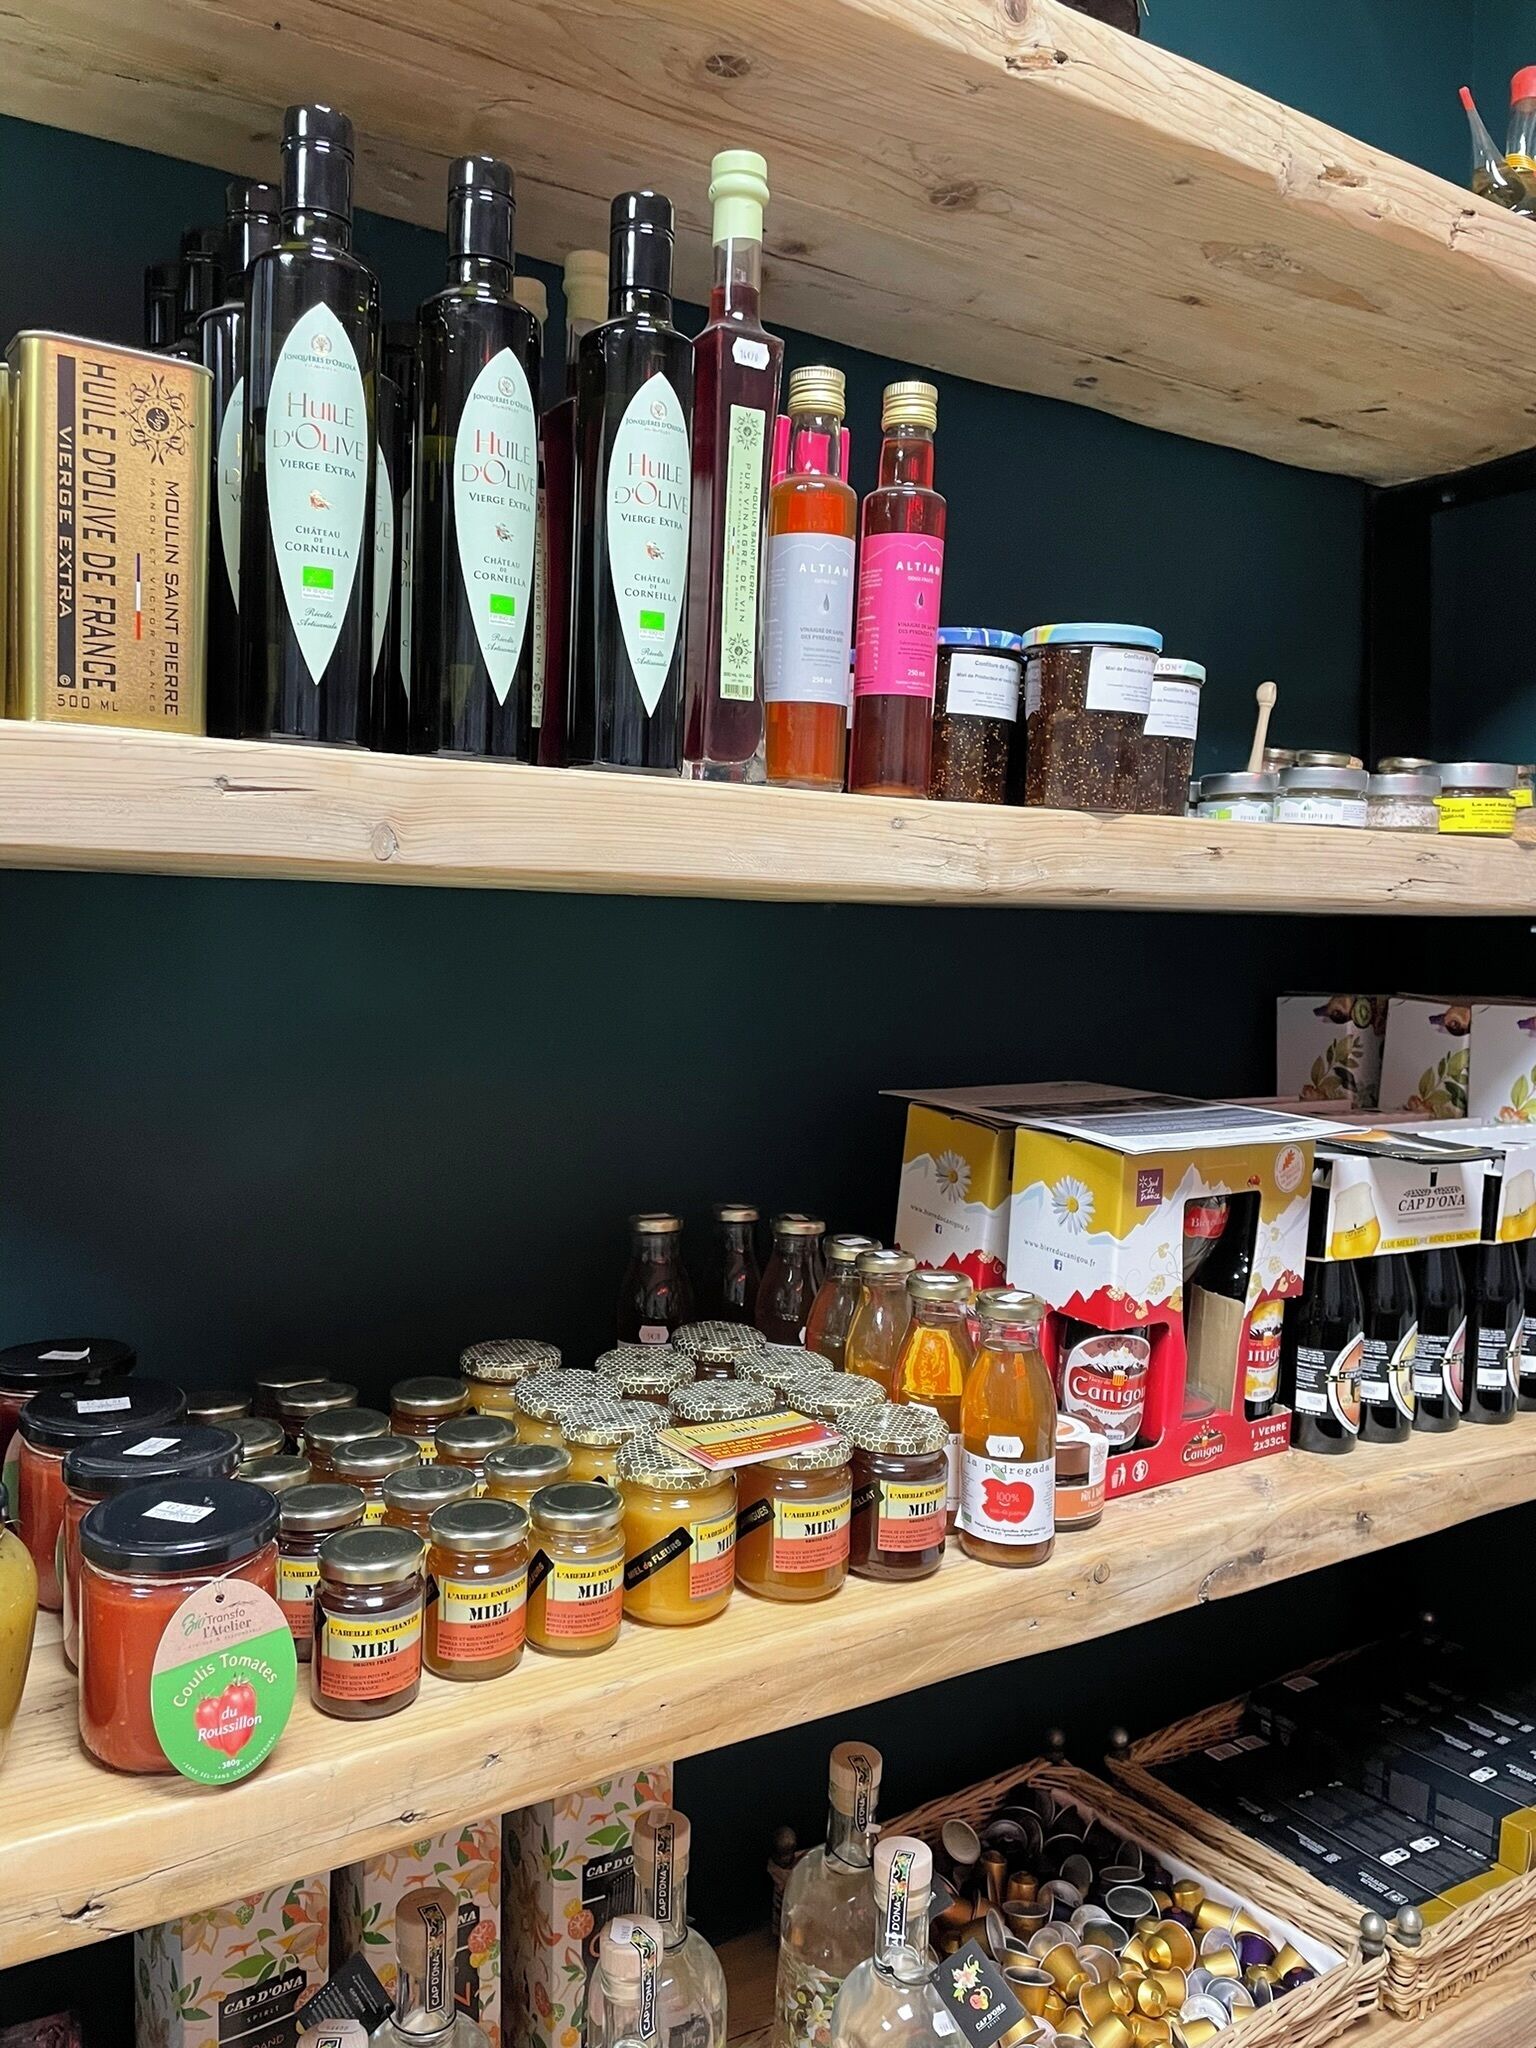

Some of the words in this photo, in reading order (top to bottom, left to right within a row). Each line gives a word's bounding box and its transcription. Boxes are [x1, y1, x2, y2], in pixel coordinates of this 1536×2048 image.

[82, 361, 116, 440] HUILE
[288, 392, 354, 428] HUILE
[273, 422, 365, 462] D'OLIVE
[476, 430, 530, 465] HUILE
[58, 426, 73, 525] VIERGE
[280, 458, 320, 471] VIERGE
[325, 464, 356, 479] EXTRA
[462, 459, 535, 497] D'OLIVE
[628, 453, 683, 485] HUILE
[82, 448, 116, 544] D'OLIVE
[469, 492, 505, 505] VIERGE
[509, 498, 530, 512] EXTRA
[615, 481, 688, 515] D'OLIVE
[751, 487, 759, 522] MOULIN
[165, 480, 179, 564] MOULIN
[295, 525, 340, 539] CHÂTEAU
[621, 513, 656, 525] VIERGE
[659, 517, 683, 530] EXTRA
[741, 498, 750, 566] VINAIGRE
[150, 548, 156, 566] ET
[285, 541, 349, 559] CORNEILLA
[82, 552, 116, 587] DE
[484, 555, 520, 569] CHÂTEAU
[58, 535, 73, 618] EXTRA
[474, 570, 526, 588] CORNEILLA
[634, 573, 671, 585] CHÂTEAU
[740, 575, 747, 592] DE
[165, 573, 179, 635] SAINT
[625, 587, 677, 602] CORNEILLA
[82, 594, 116, 692] FRANCE
[165, 641, 179, 715] PIERRE
[907, 669, 919, 677] 250
[57, 693, 90, 709] 500
[100, 701, 119, 712] ML
[1398, 1197, 1425, 1212] CAP
[1426, 1194, 1465, 1209] D'ONA
[1259, 1421, 1287, 1437] VERRE
[1183, 1442, 1224, 1463] Canigou
[1253, 1435, 1287, 1452] 2x33CL
[966, 1454, 978, 1467] la
[996, 1491, 1020, 1503] 100%
[784, 1510, 821, 1519] L'ABEILLE
[908, 1500, 939, 1517] MIEL
[804, 1518, 838, 1536] MIEL
[652, 1537, 682, 1564] FLEURS
[556, 1569, 597, 1580] L'ABEILLE
[447, 1592, 489, 1601] L'ABEILLE
[578, 1579, 615, 1599] MIEL
[207, 1608, 246, 1626] Transfo
[469, 1600, 512, 1621] MIEL
[202, 1618, 253, 1639] l'Atelier
[330, 1627, 373, 1637] L'ABEILLE
[352, 1638, 399, 1659] MIEL
[173, 1662, 216, 1708] Coulis
[219, 1653, 278, 1685] Tomates
[221, 1705, 238, 1720] du
[197, 1712, 263, 1742] Roussillon
[586, 1861, 613, 1879] CAP
[658, 1869, 668, 1897] D'ONA
[658, 1897, 667, 1918] CAP
[891, 1900, 902, 1932] D'ONA
[432, 1955, 441, 1984] D'ONA
[223, 1995, 256, 2015] CAP
[256, 1975, 304, 2003] D'ONA
[431, 1986, 440, 2006] CAP
[644, 1977, 652, 2011] D'ONA
[643, 2010, 651, 2031] CAP
[975, 2016, 988, 2030] CAP
